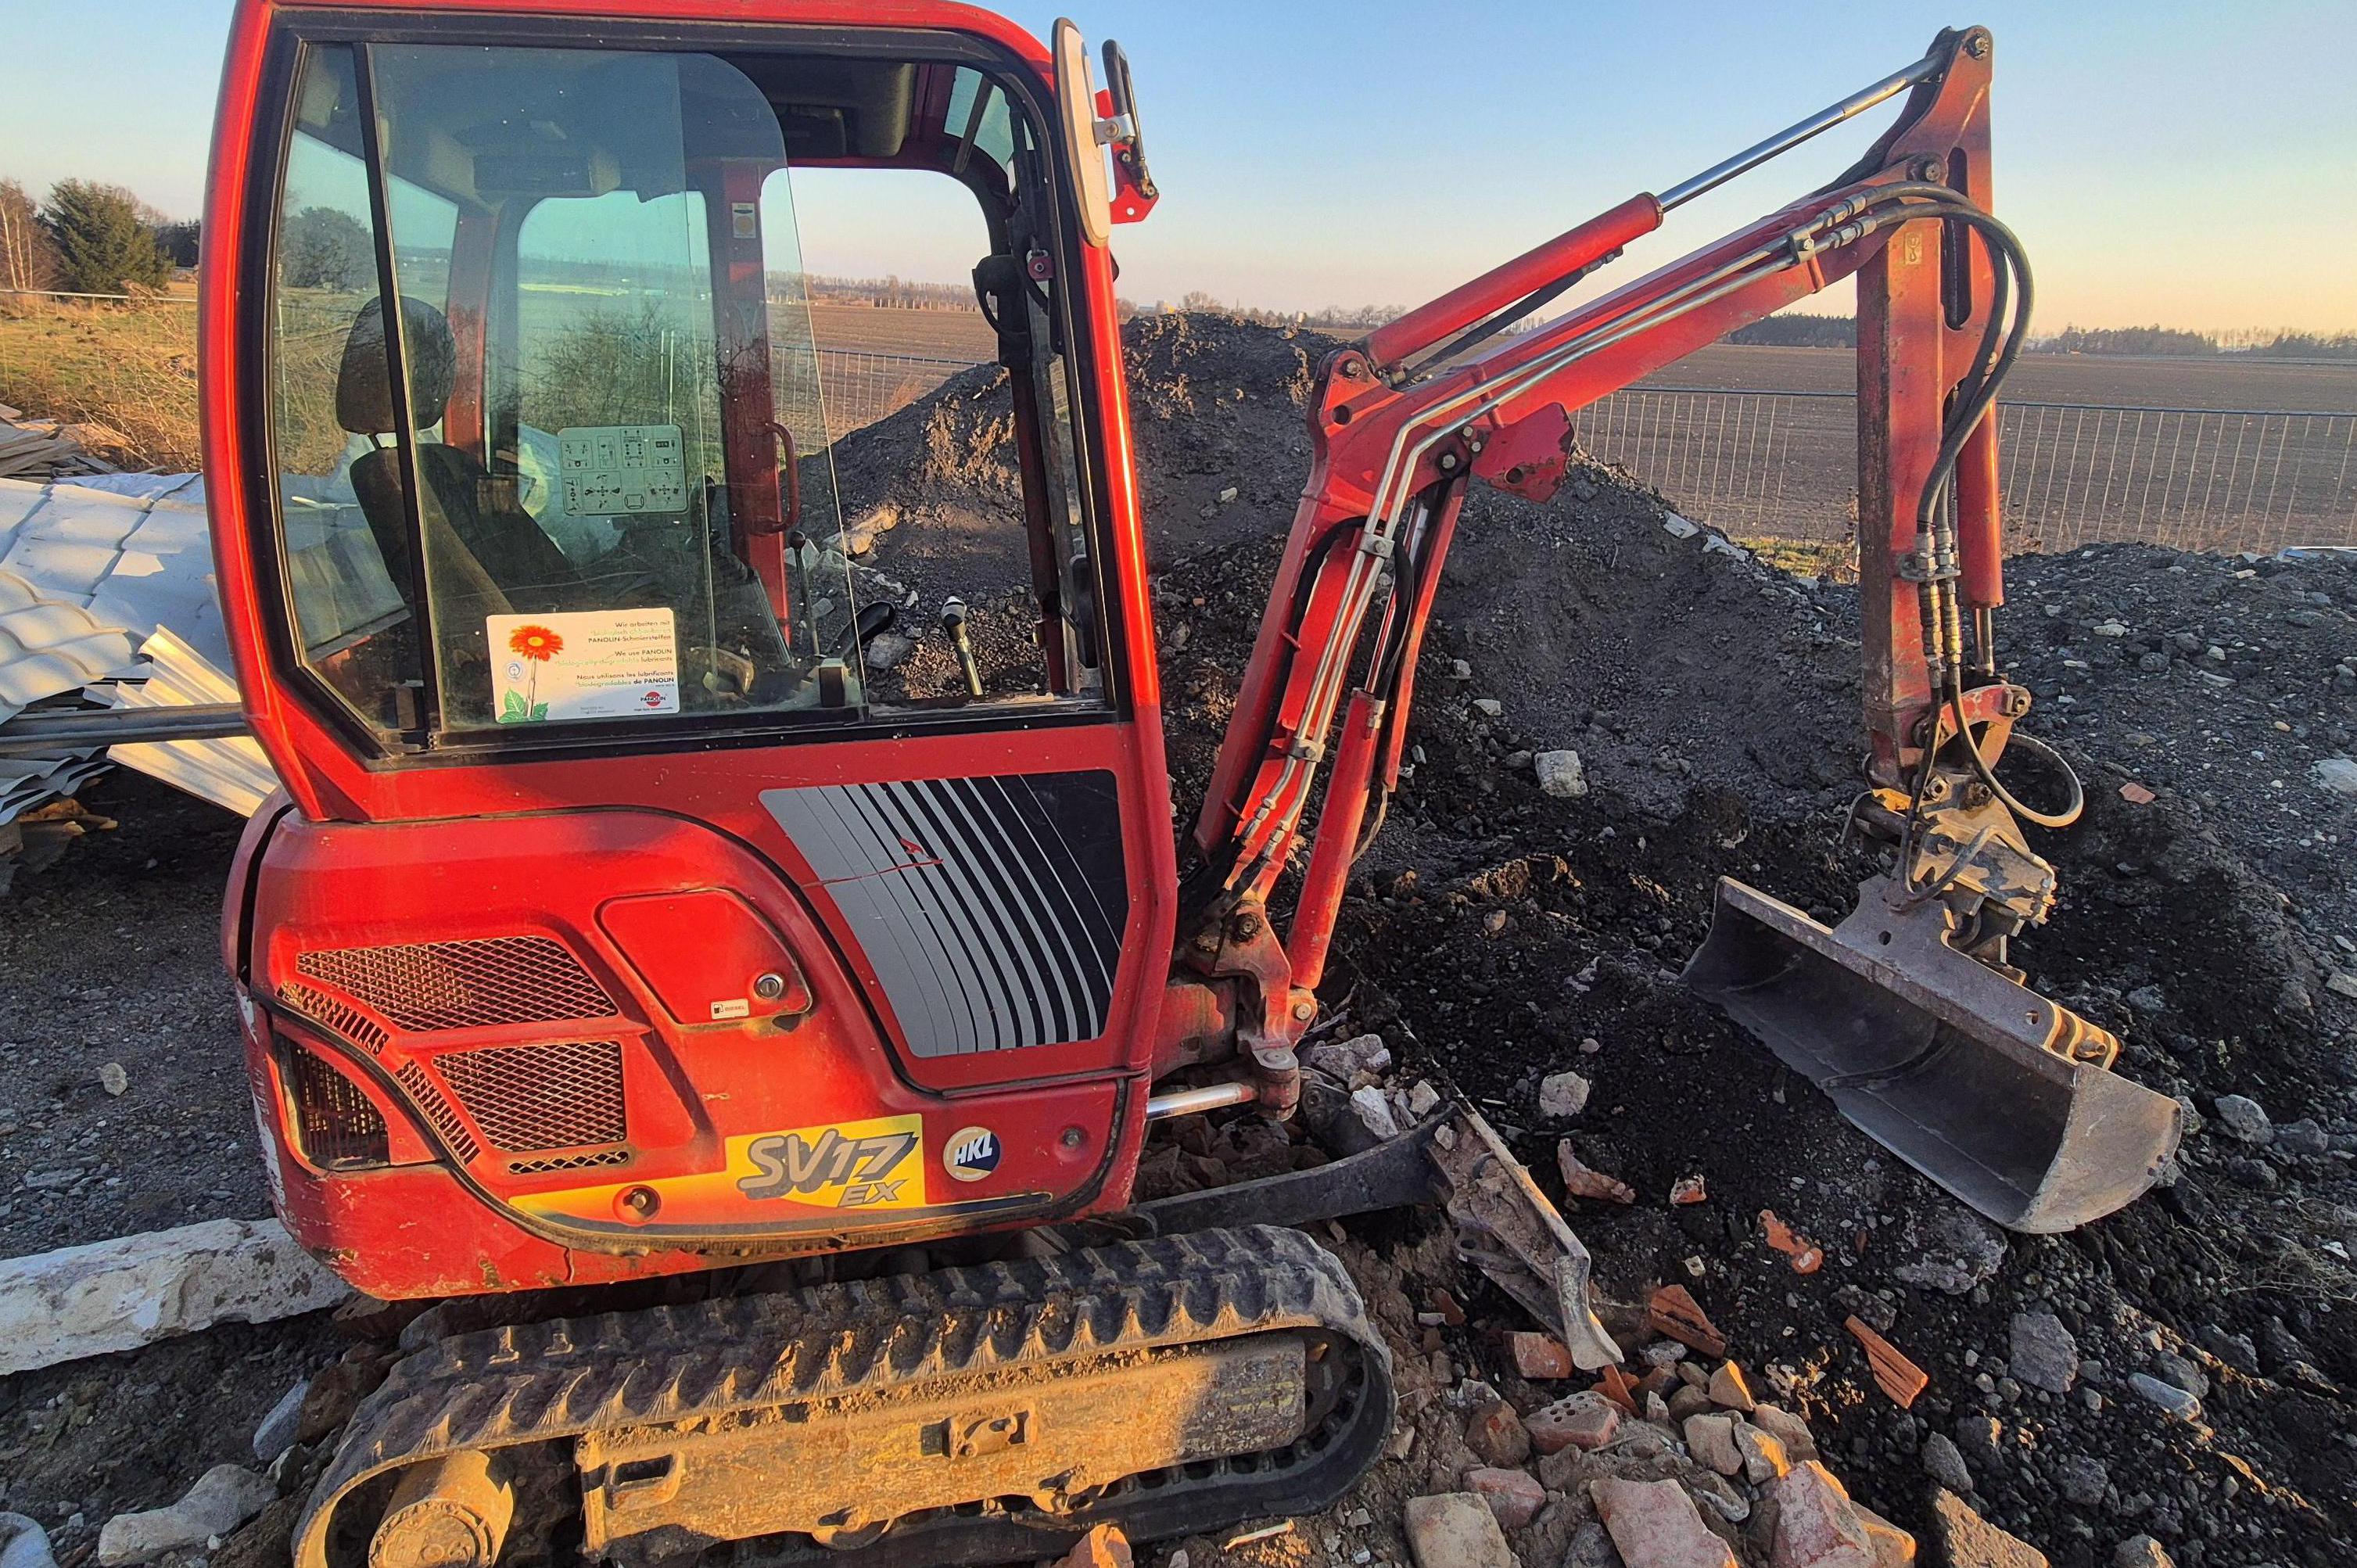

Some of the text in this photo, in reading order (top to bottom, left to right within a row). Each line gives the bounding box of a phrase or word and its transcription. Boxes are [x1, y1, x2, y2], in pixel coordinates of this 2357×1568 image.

[737, 1128, 917, 1197] SV17
[952, 1132, 993, 1165] HKL
[838, 1179, 909, 1207] EX
